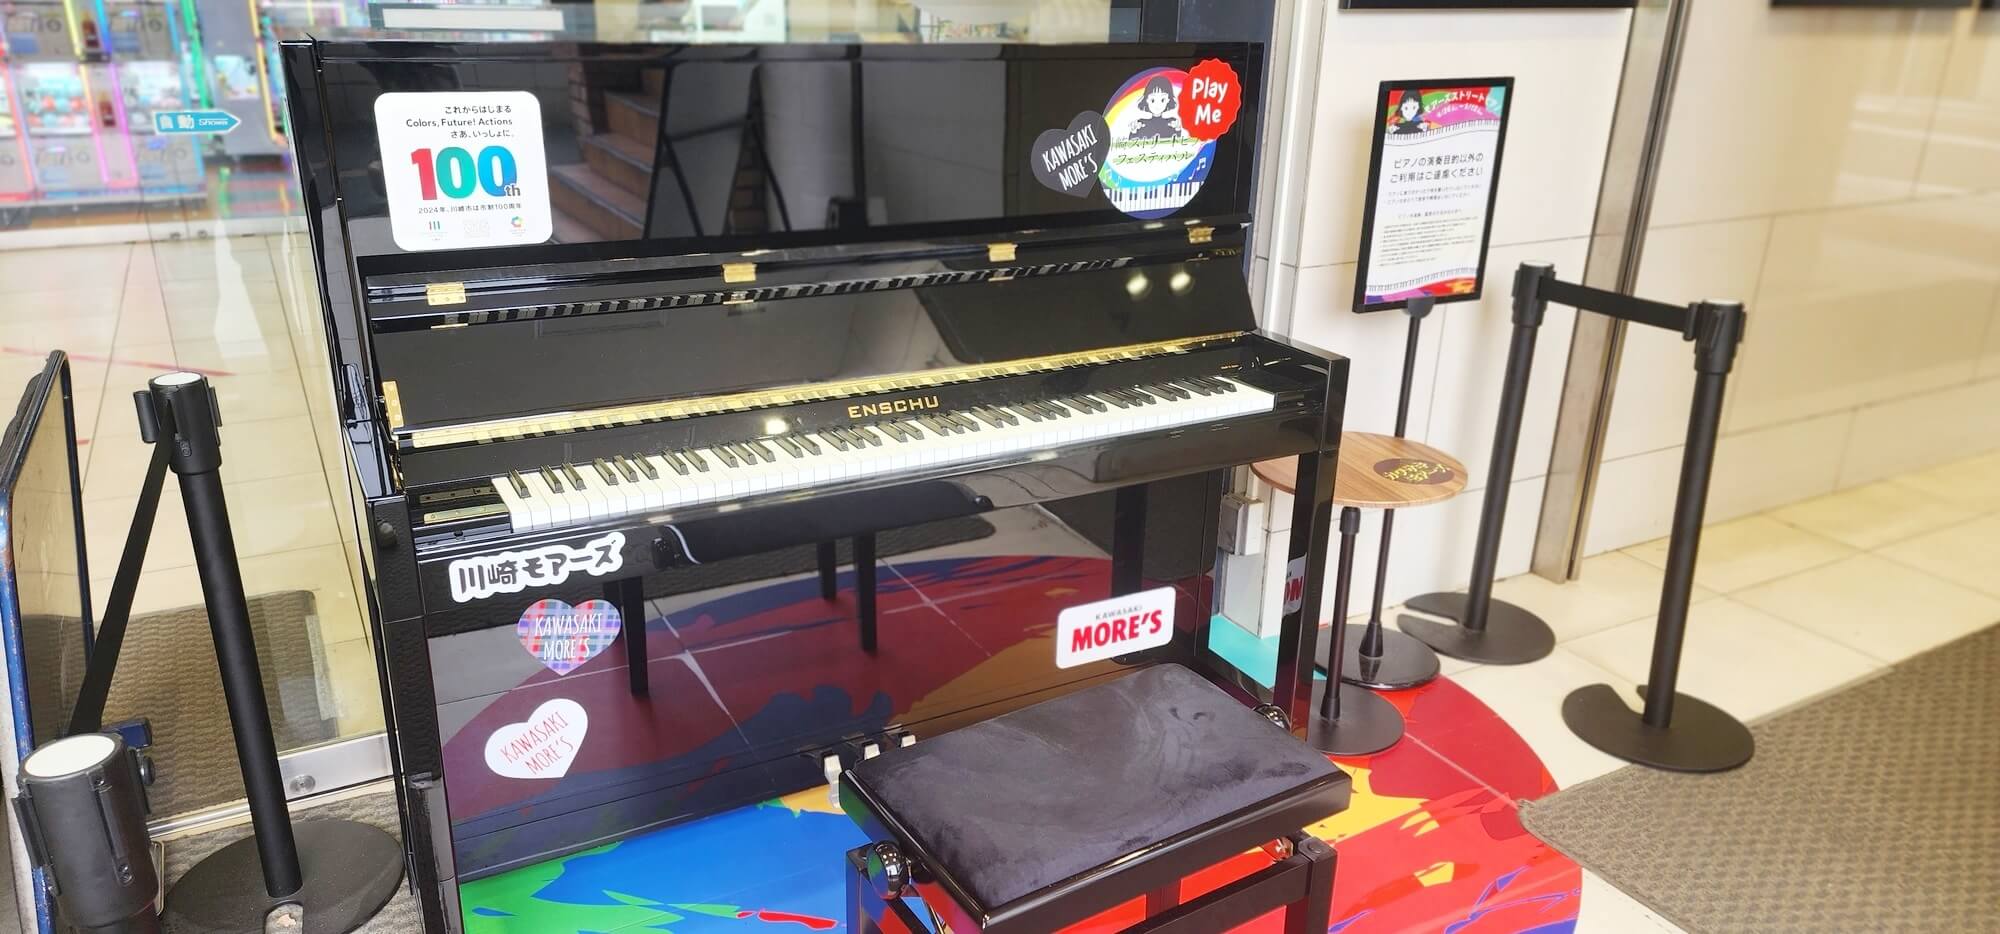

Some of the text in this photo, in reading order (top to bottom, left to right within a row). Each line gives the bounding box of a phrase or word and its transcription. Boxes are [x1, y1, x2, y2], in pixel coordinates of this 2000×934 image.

[1192, 78, 1228, 102] Play
[444, 105, 512, 114] これからはじまる
[1195, 105, 1222, 126] Me
[406, 117, 513, 129] Colors, Future! Actions
[1042, 124, 1098, 173] KAWASAKI
[847, 395, 940, 419] ENSCHU
[459, 539, 617, 594] 川崎モアーズ
[1095, 605, 1143, 620] KAWASAKI
[535, 613, 603, 637] KAWASAKI
[1071, 609, 1163, 653] MORE'S
[500, 711, 569, 764] KAWASAKI
